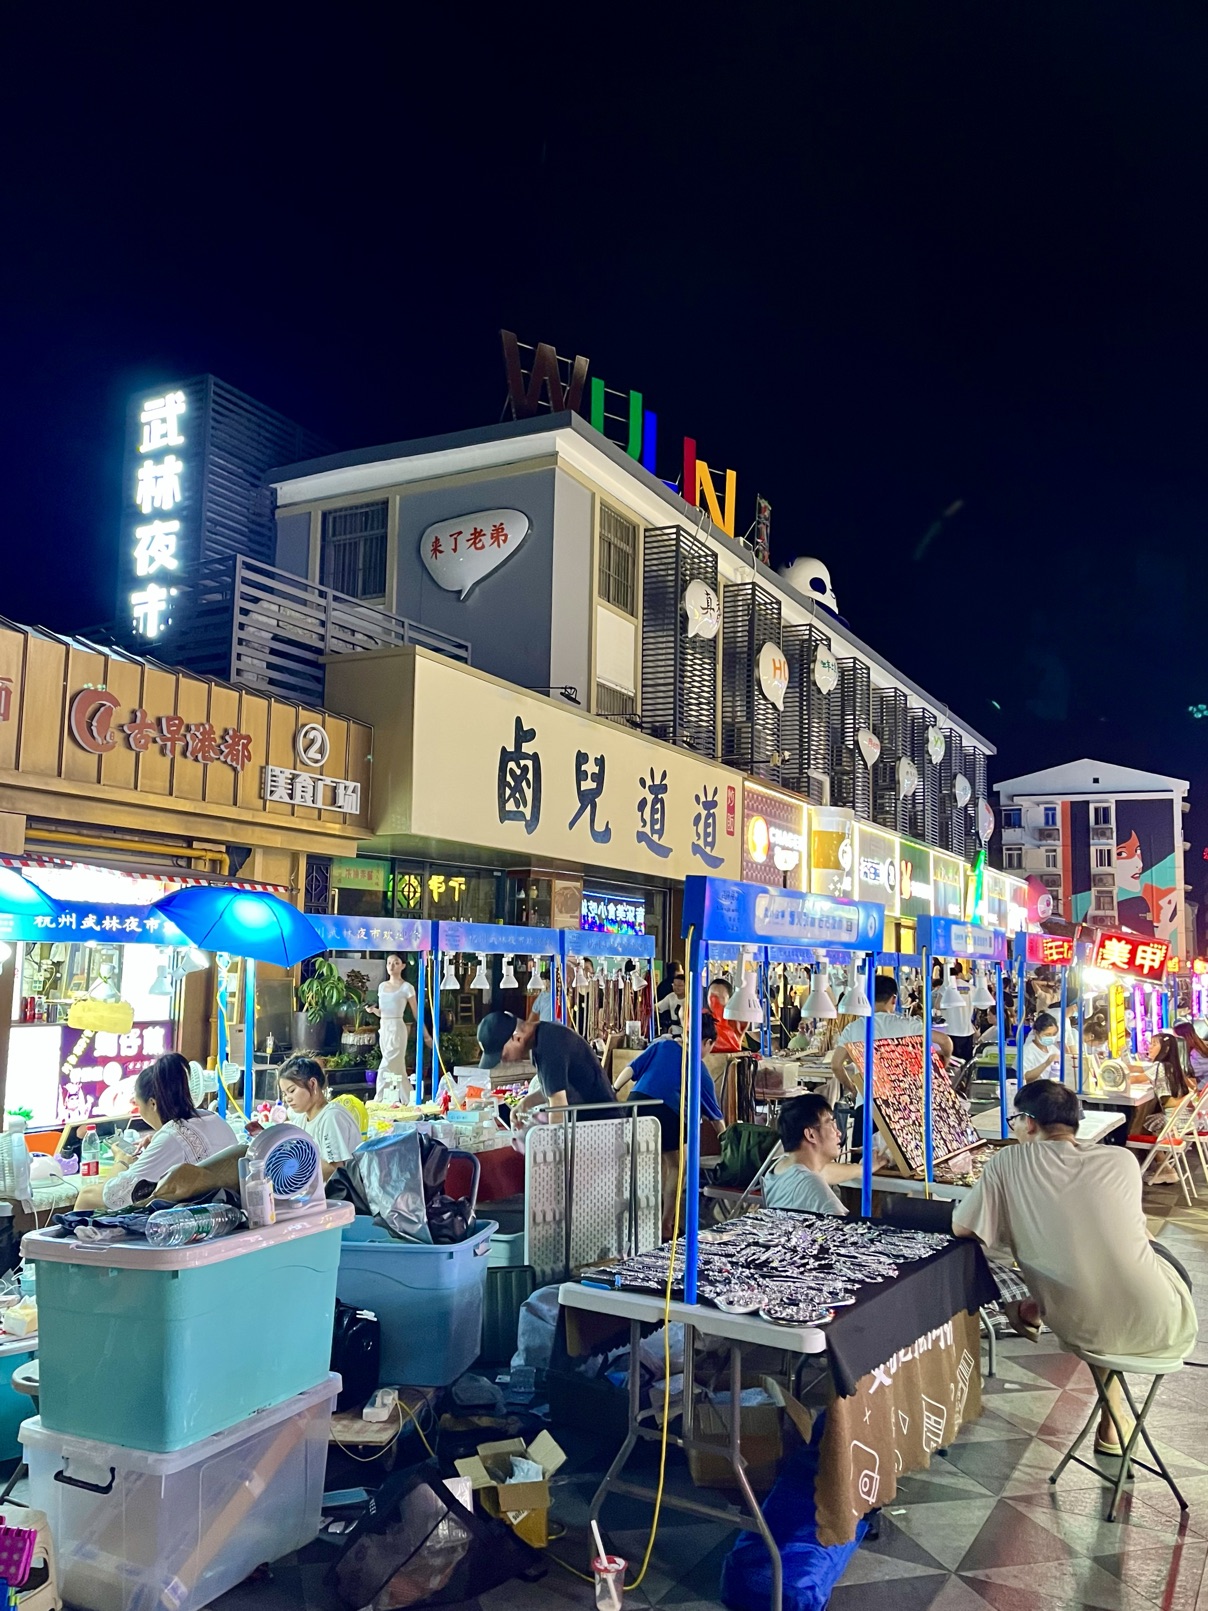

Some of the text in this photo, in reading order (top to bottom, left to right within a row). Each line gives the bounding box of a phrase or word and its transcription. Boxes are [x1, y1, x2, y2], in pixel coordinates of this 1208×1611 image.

[130, 389, 186, 639] 武林夜市
[429, 521, 509, 561] 来了老弟
[123, 708, 253, 772] 古早港都
[267, 767, 361, 813] 美食广场
[1101, 937, 1163, 975] 美甲
